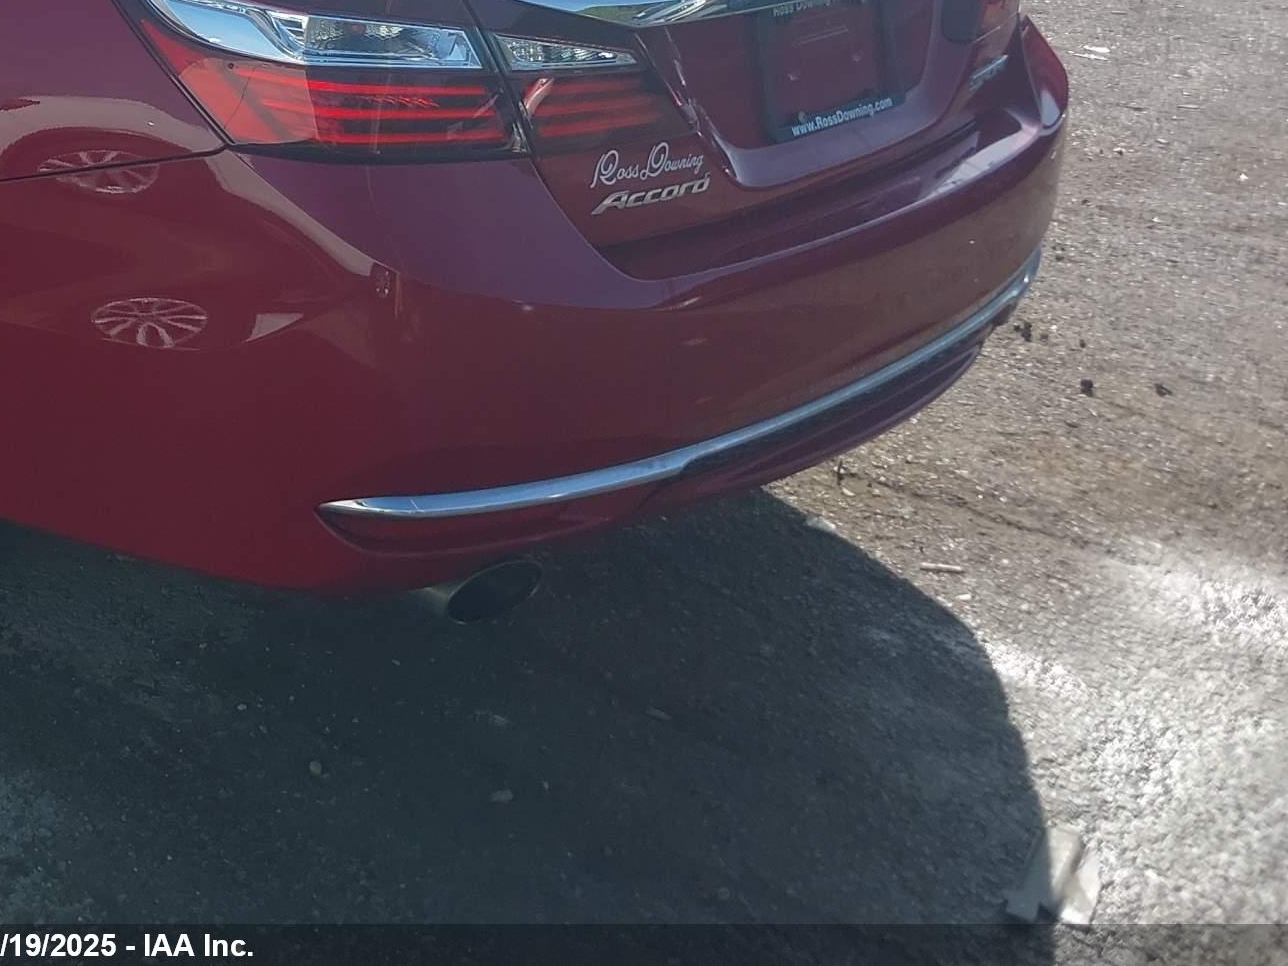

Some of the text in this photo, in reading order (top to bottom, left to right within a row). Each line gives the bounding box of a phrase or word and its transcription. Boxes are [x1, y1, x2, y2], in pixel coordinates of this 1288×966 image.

[791, 97, 893, 136] www.RossDowning.com
[590, 141, 704, 188] Ross Downing
[590, 171, 712, 215] Accord
